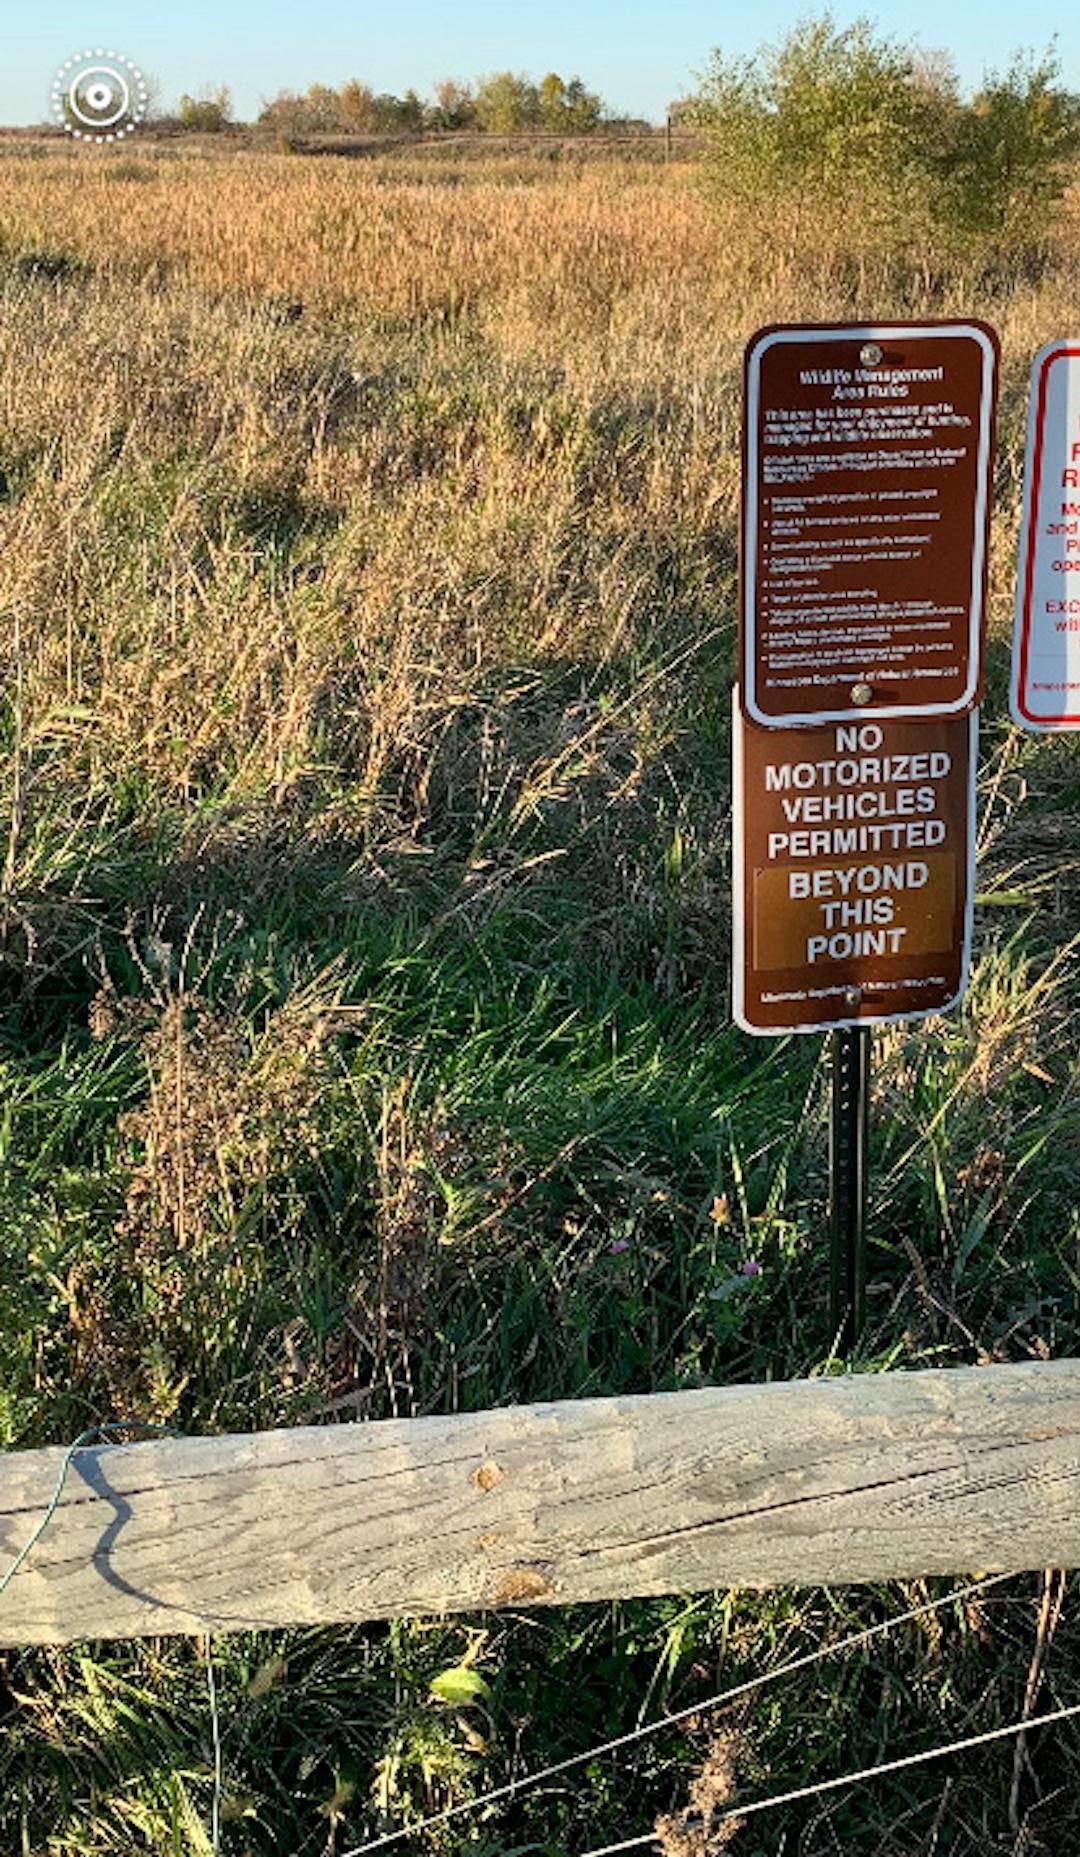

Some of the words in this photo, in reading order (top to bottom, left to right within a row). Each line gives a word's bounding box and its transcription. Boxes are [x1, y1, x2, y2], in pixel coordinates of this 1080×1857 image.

[832, 384, 865, 399] Area
[868, 383, 909, 397] Rules
[854, 366, 944, 384] Management
[1046, 521, 1076, 535] and
[836, 724, 883, 752] NO
[765, 752, 950, 791] MOTORIZED
[782, 786, 936, 823] VEHICLES
[768, 820, 946, 859] PERMITTED
[789, 861, 928, 899] BEYOND
[820, 896, 894, 930] THIS
[807, 927, 906, 964] POINT
